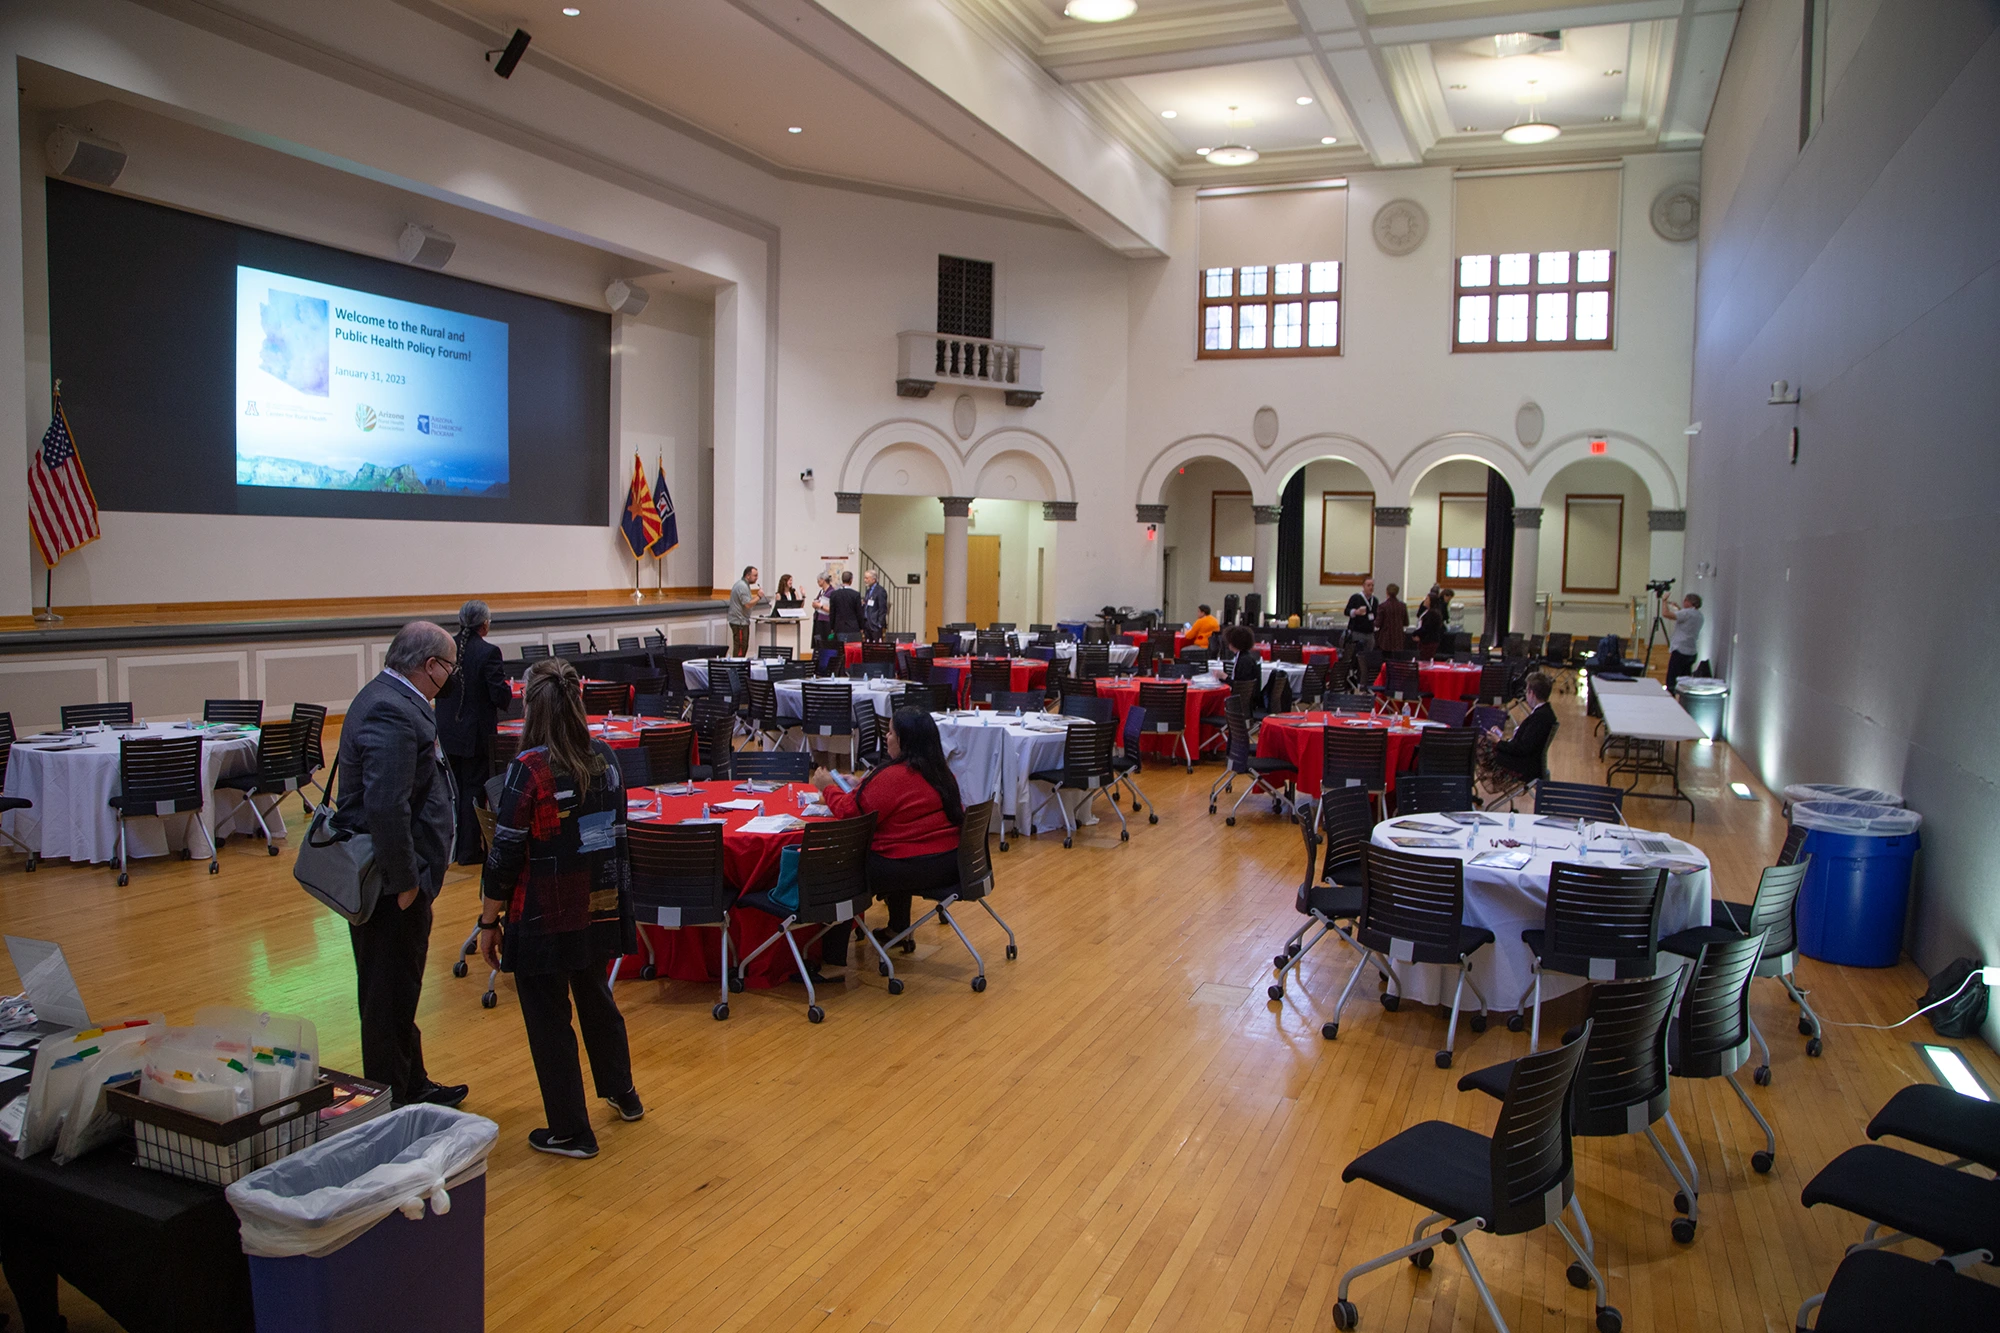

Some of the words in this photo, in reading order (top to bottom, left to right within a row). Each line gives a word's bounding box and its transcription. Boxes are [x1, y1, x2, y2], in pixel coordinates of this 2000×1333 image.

[335, 307, 385, 328] Welcome
[387, 318, 399, 330] to
[401, 320, 418, 334] the
[420, 324, 445, 339] Rural
[447, 329, 465, 343] and
[335, 328, 368, 344] Public
[370, 333, 404, 350] Health
[407, 340, 435, 358] Policy
[438, 346, 471, 362] Forum!
[335, 366, 368, 381] January
[371, 371, 383, 384] 31,
[385, 373, 406, 386] 2023
[378, 411, 404, 420] Arizona
